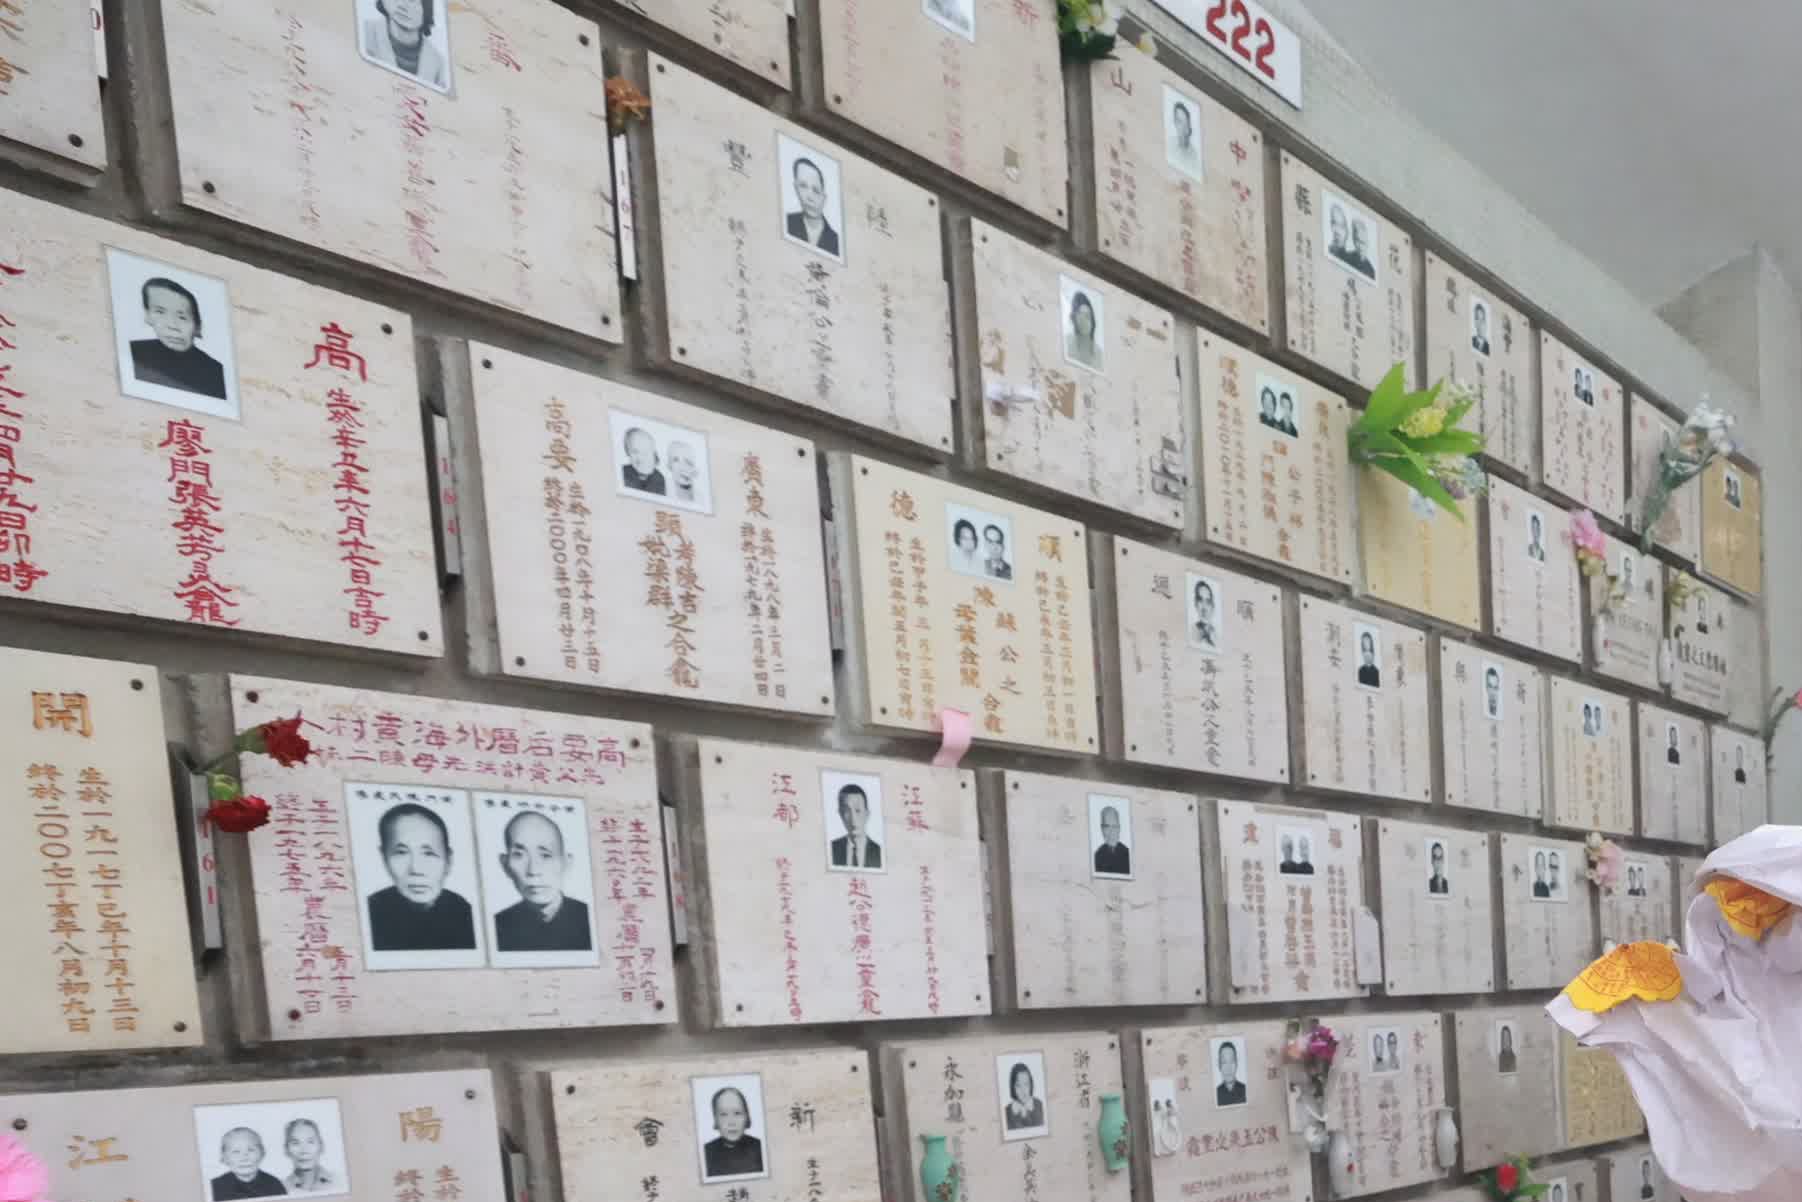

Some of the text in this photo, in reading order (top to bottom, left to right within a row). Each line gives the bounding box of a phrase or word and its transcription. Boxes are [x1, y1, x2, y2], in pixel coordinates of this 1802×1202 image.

[1205, 0, 1275, 80] 222
[303, 321, 368, 382] 高
[31, 690, 96, 739] 開
[398, 1105, 444, 1144] 陽
[66, 1133, 129, 1170] 江
